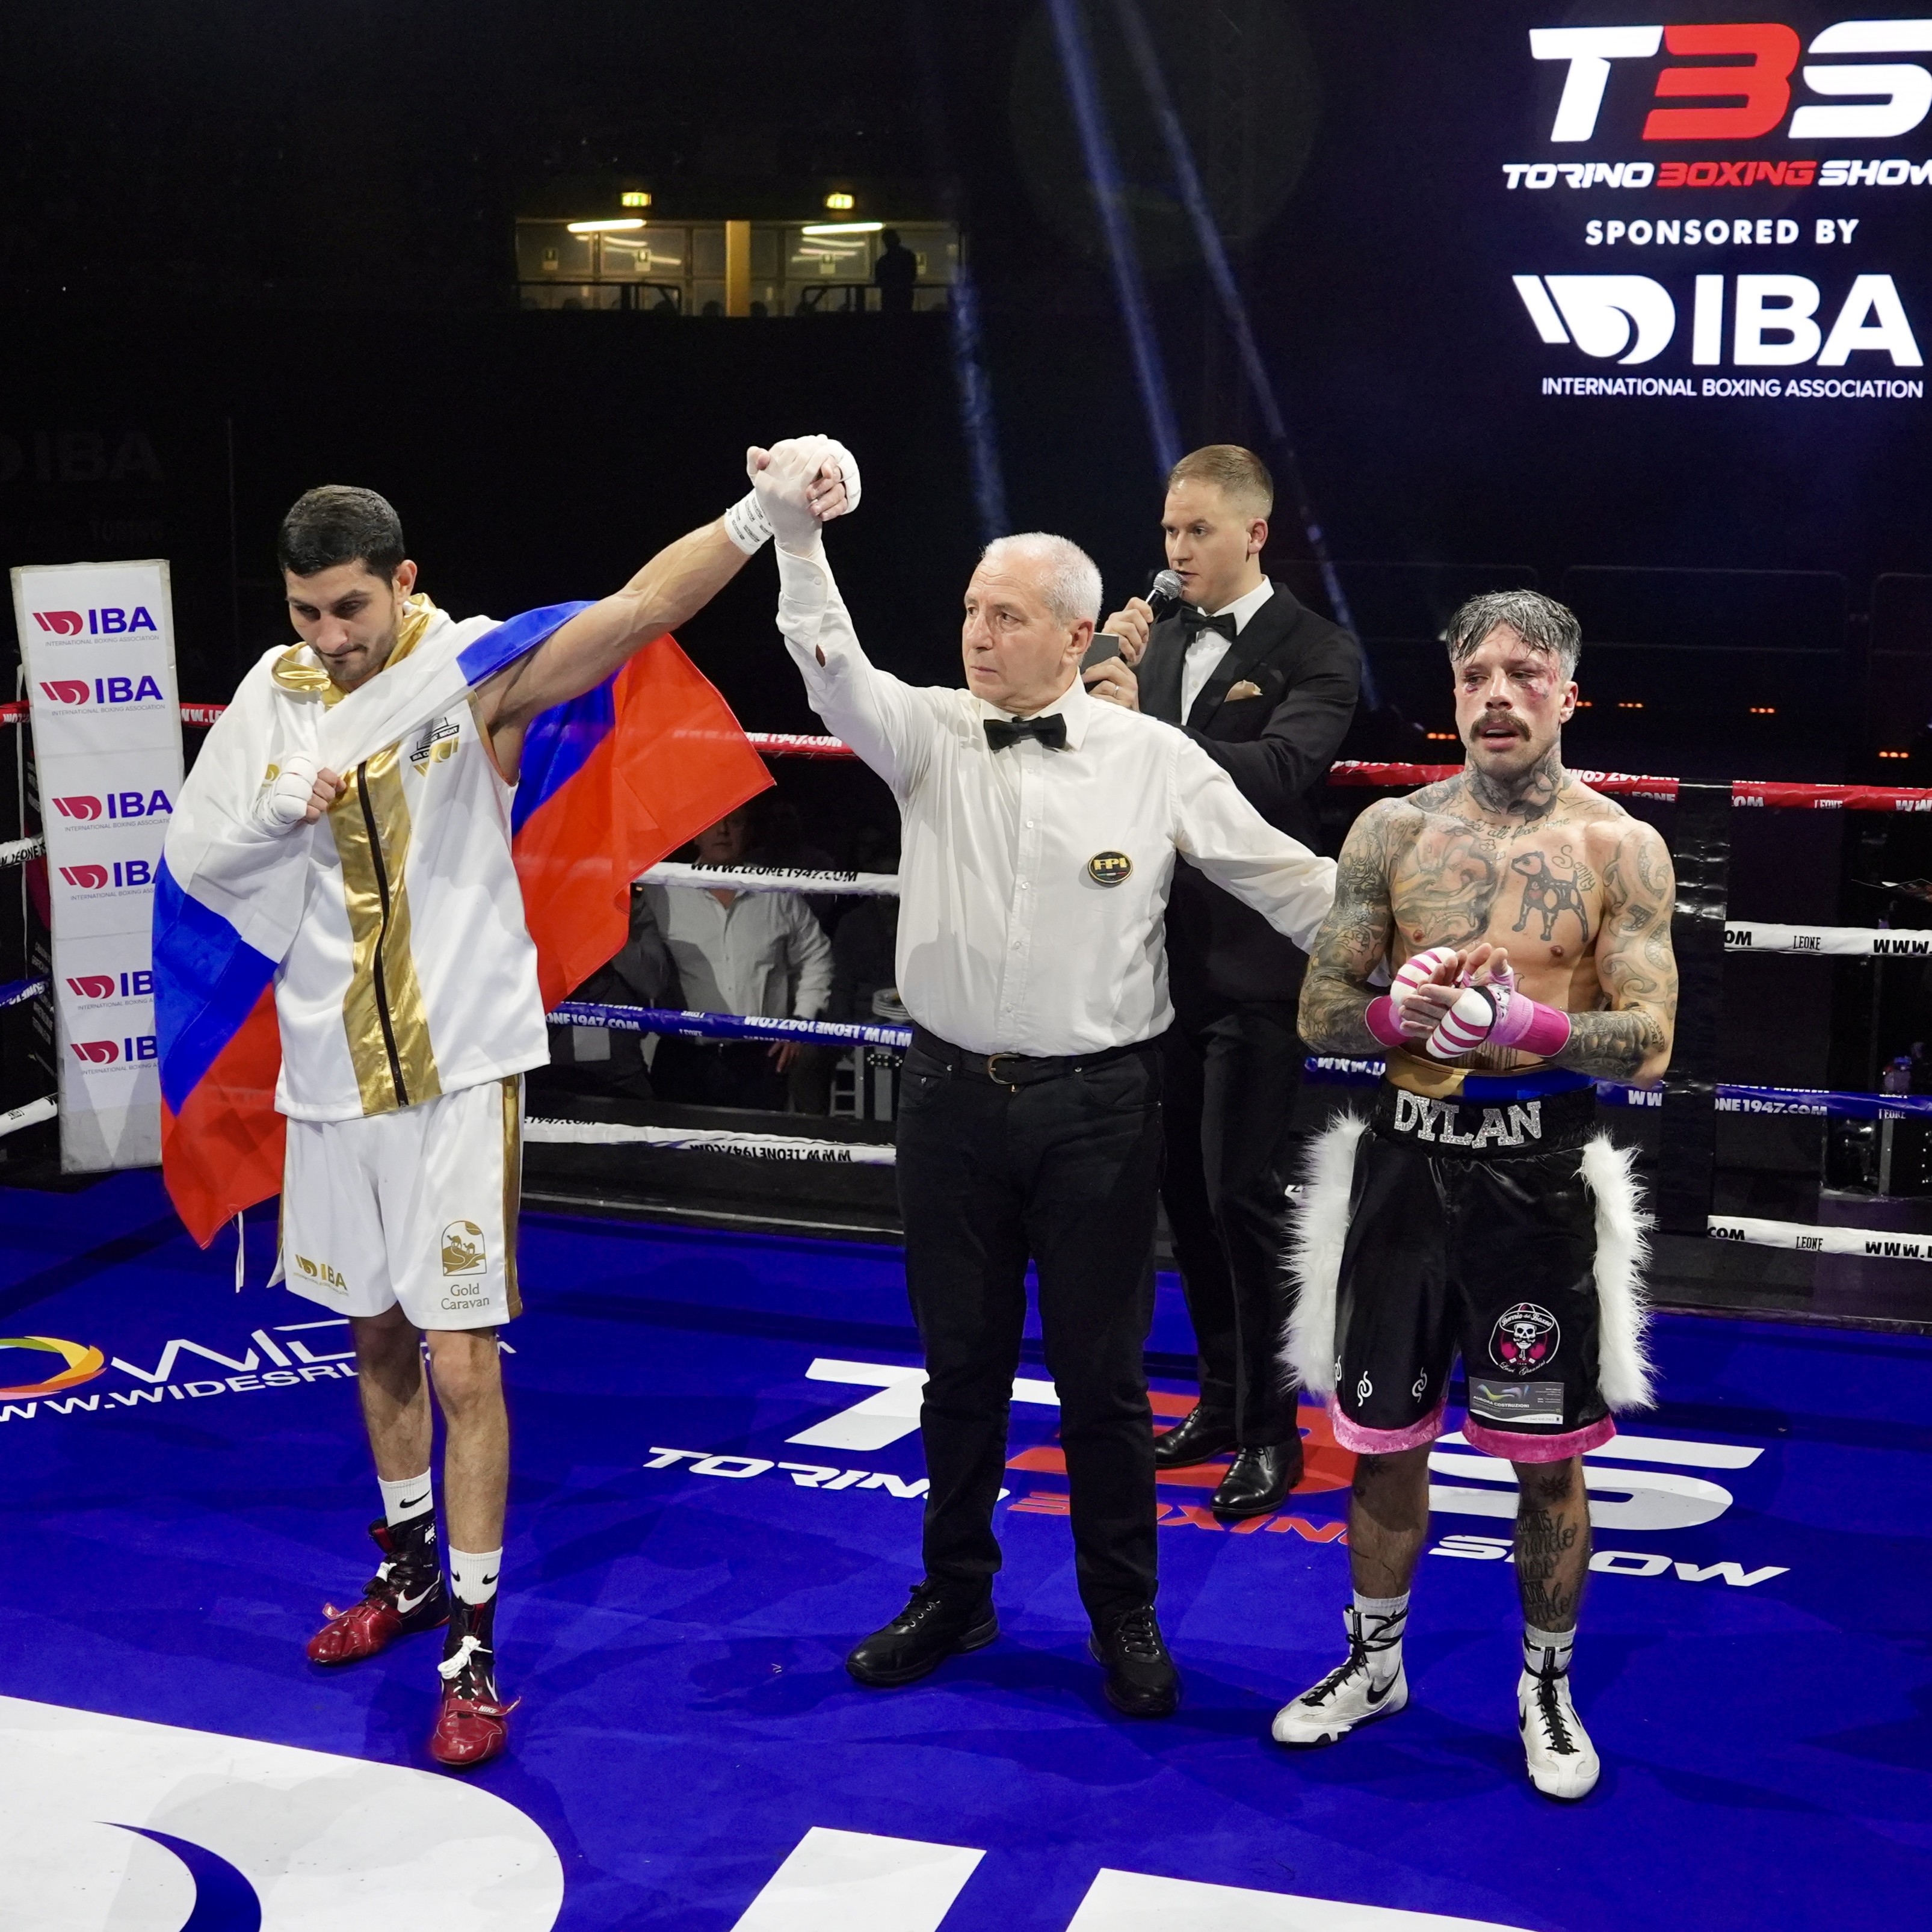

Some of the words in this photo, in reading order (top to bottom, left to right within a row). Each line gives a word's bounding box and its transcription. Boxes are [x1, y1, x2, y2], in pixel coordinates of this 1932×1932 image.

[1502, 163, 1654, 189] TORINO
[1656, 161, 1817, 187] BOXING
[1585, 220, 1800, 245] SPONSORED
[1815, 219, 1860, 244] BY
[1693, 274, 1924, 366] IBA
[1542, 377, 1697, 395] INTERNATIONAL
[1702, 379, 1782, 397] BOXING
[1785, 380, 1924, 398] ASSOCIATION
[88, 606, 157, 635] IBA
[95, 676, 163, 703] IBA
[52, 708, 99, 716] INTERNATIONAL
[108, 790, 173, 818] IBA
[1732, 795, 1764, 807] OM
[1552, 844, 1597, 893] Sonny
[70, 892, 117, 901] INTERNATIONAL
[119, 889, 142, 897] BOXING
[1793, 936, 1821, 951] LEONE
[78, 1001, 123, 1010] INTERNATIONAL
[82, 1066, 127, 1075] INTERNATIONAL
[1394, 1090, 1542, 1149] DYLAN
[1878, 1108, 1906, 1120] LEONE
[1795, 1236, 1824, 1251] LEONE
[321, 1264, 347, 1291] IBA
[450, 1283, 480, 1297] Gold
[441, 1296, 490, 1310] Caravan
[643, 1446, 1011, 1499] TORIN
[1428, 1534, 1791, 1587] SOW
[478, 1705, 499, 1714] NIKE
